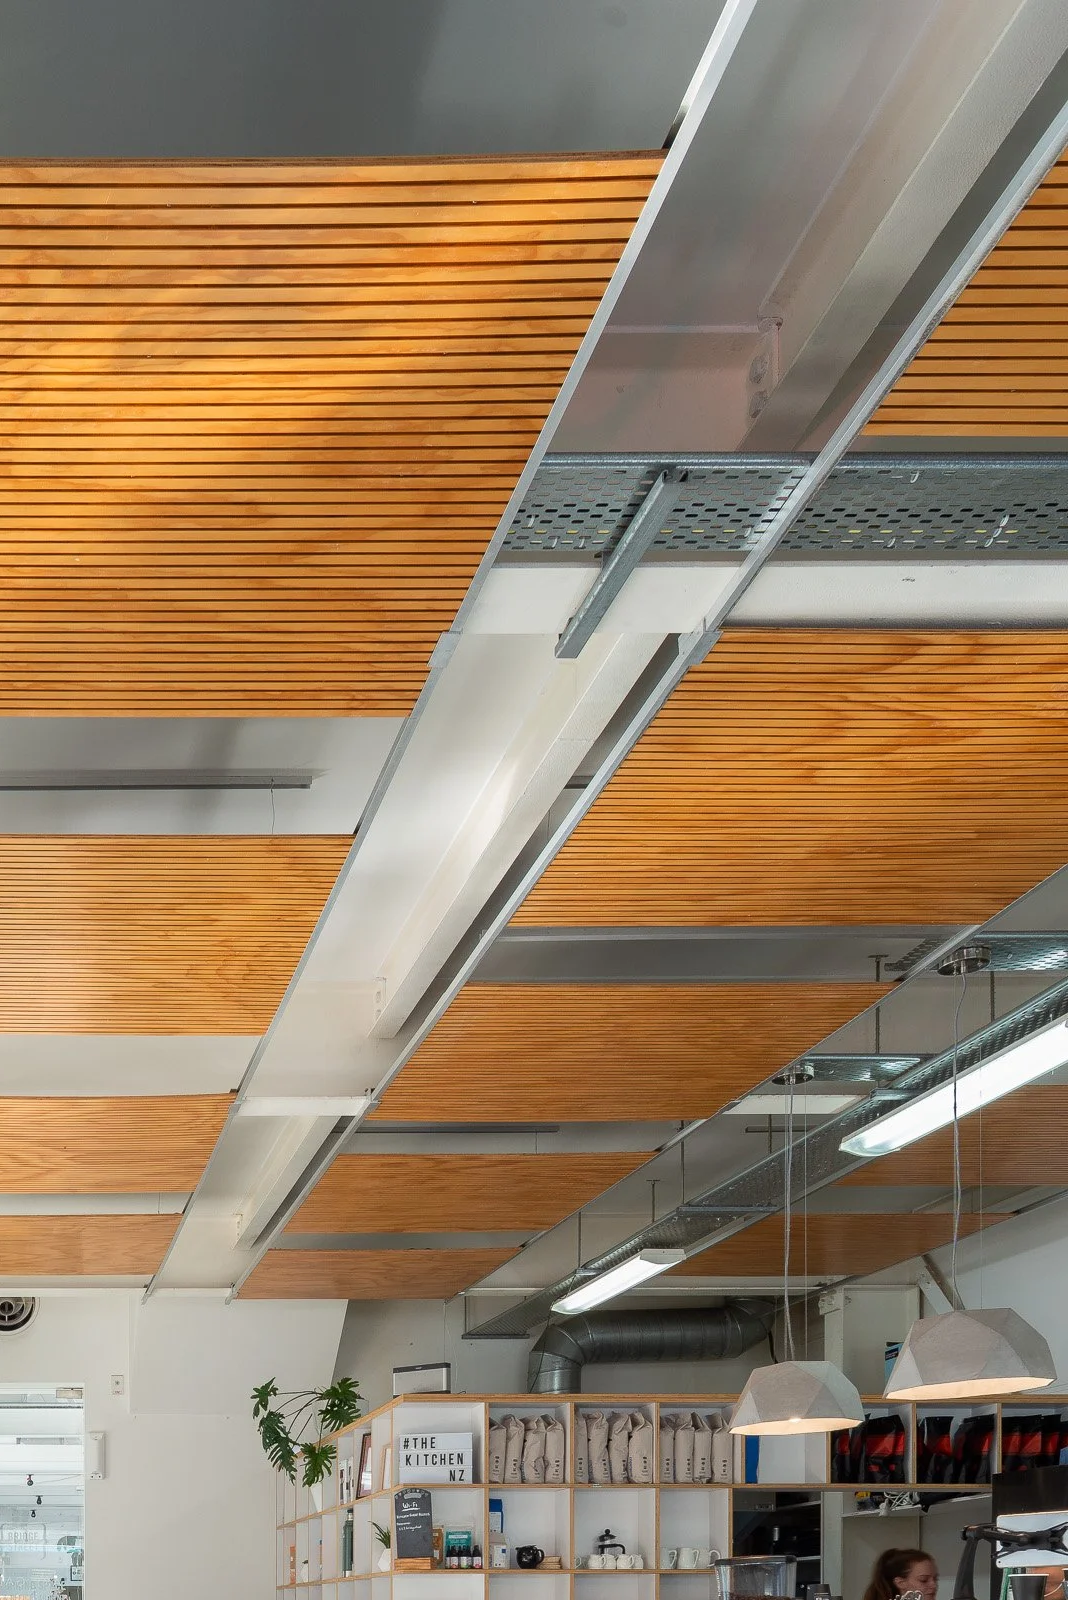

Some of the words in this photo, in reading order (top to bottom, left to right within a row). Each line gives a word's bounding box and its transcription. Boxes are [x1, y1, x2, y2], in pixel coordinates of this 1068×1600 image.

[403, 1437, 436, 1449] #THE
[405, 1453, 464, 1466] KITCHEN
[449, 1469, 465, 1482] NZ
